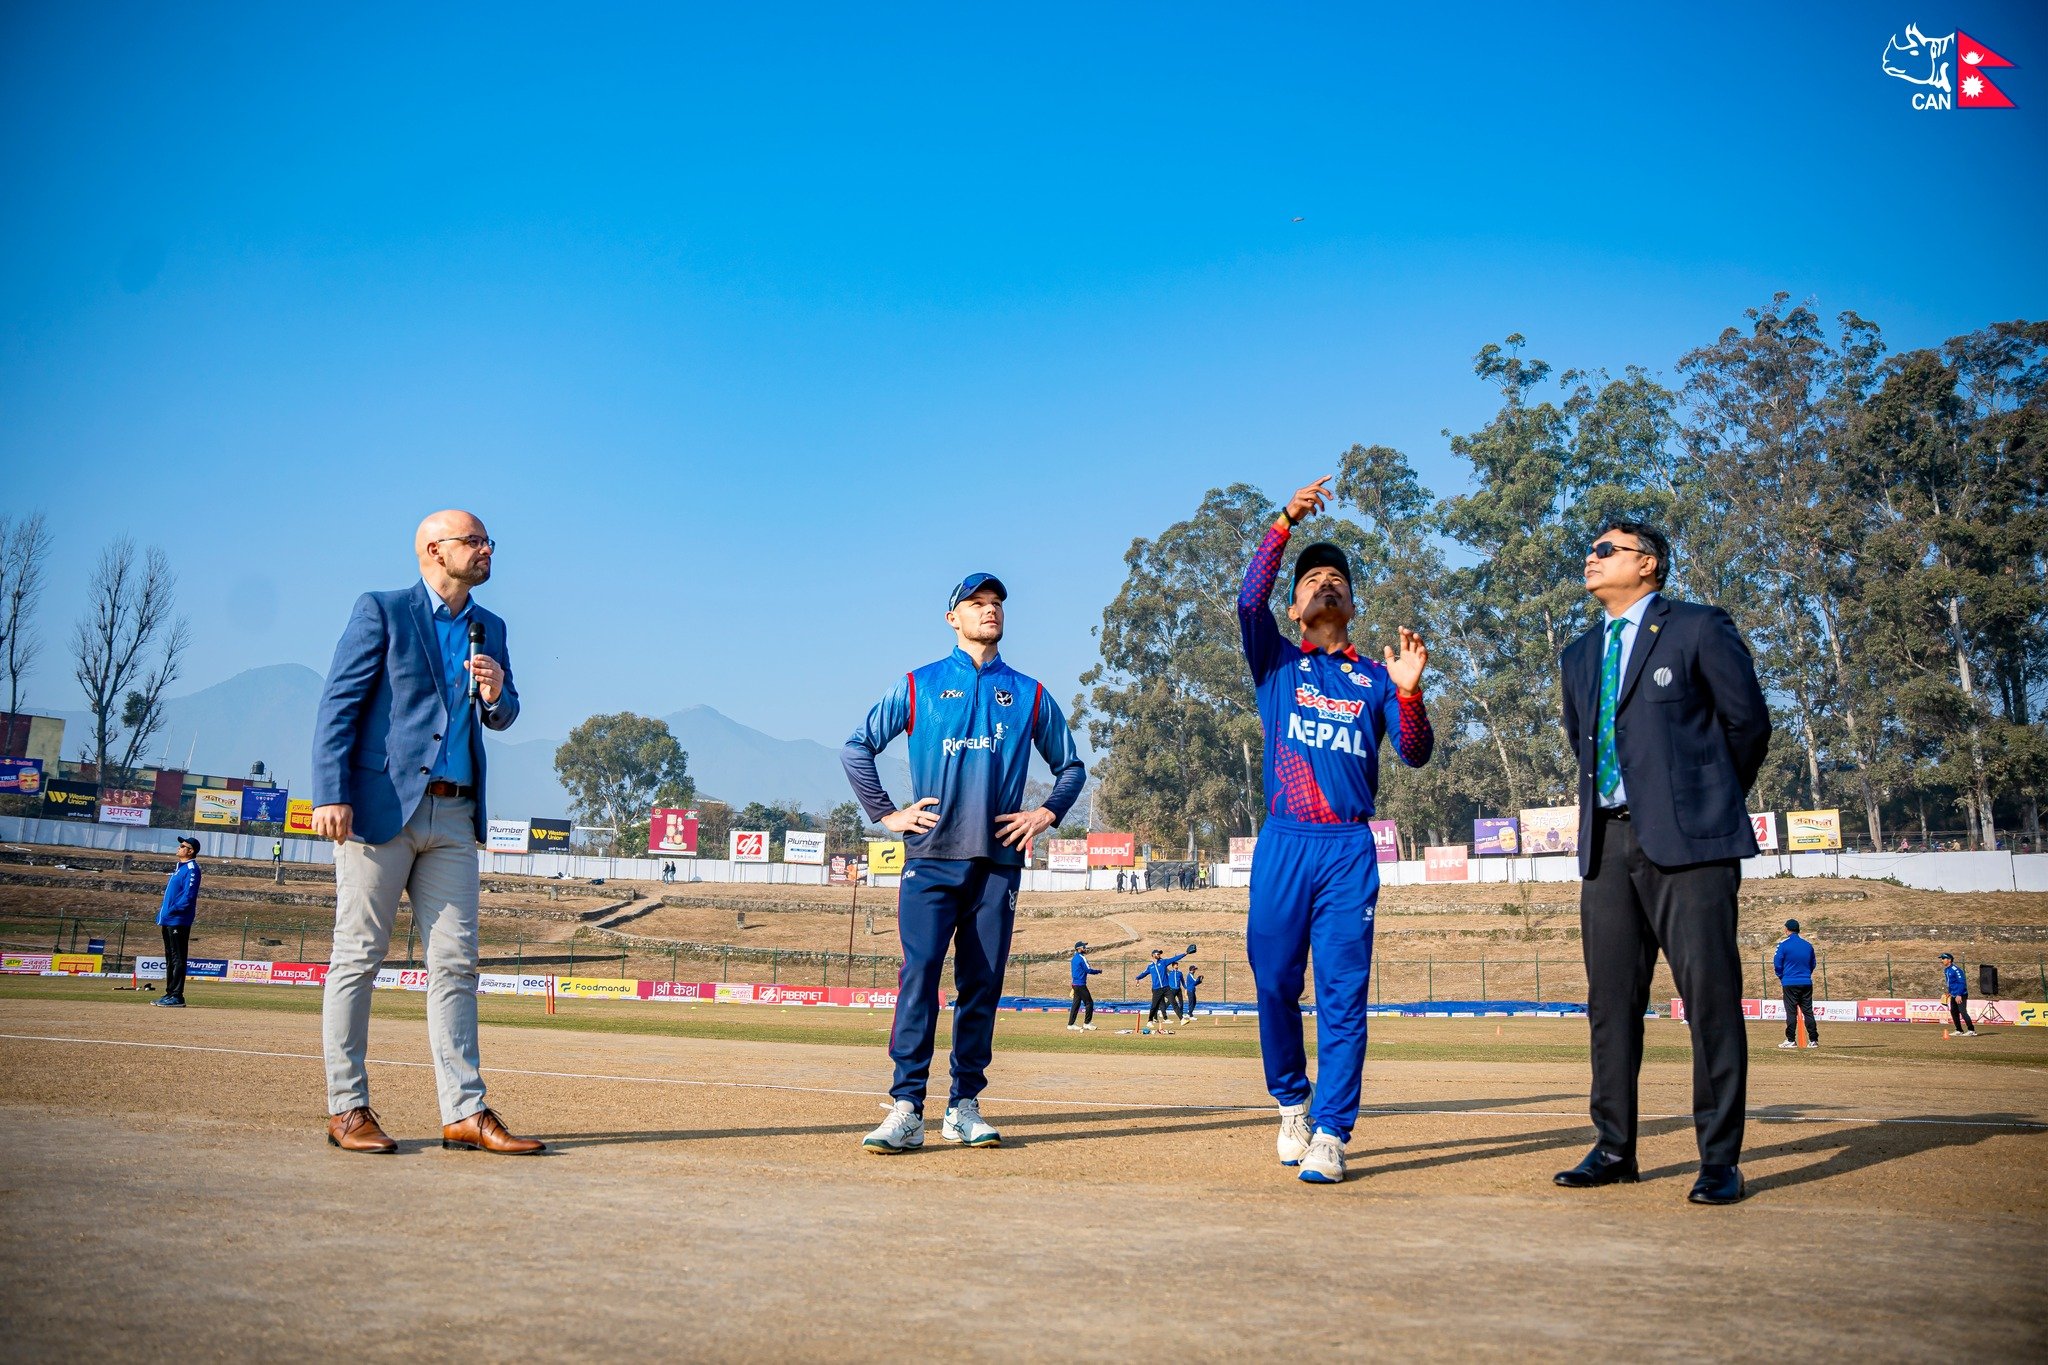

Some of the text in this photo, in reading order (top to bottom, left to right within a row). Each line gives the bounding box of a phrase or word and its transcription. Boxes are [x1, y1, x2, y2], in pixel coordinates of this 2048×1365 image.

[1296, 688, 1365, 718] Second
[1287, 712, 1367, 758] NEPAL
[68, 793, 96, 801] Western
[107, 808, 143, 818] अगस्त्य
[489, 826, 524, 834] Plumber
[787, 838, 822, 846] Plumber
[1440, 859, 1463, 868] KFC
[141, 961, 167, 970] aec
[233, 963, 269, 971] TOTAL
[575, 983, 631, 992] Foodmandu
[656, 982, 671, 995] श्री
[781, 991, 824, 1001] FIBERNET
[1874, 1006, 1904, 1016] KFC
